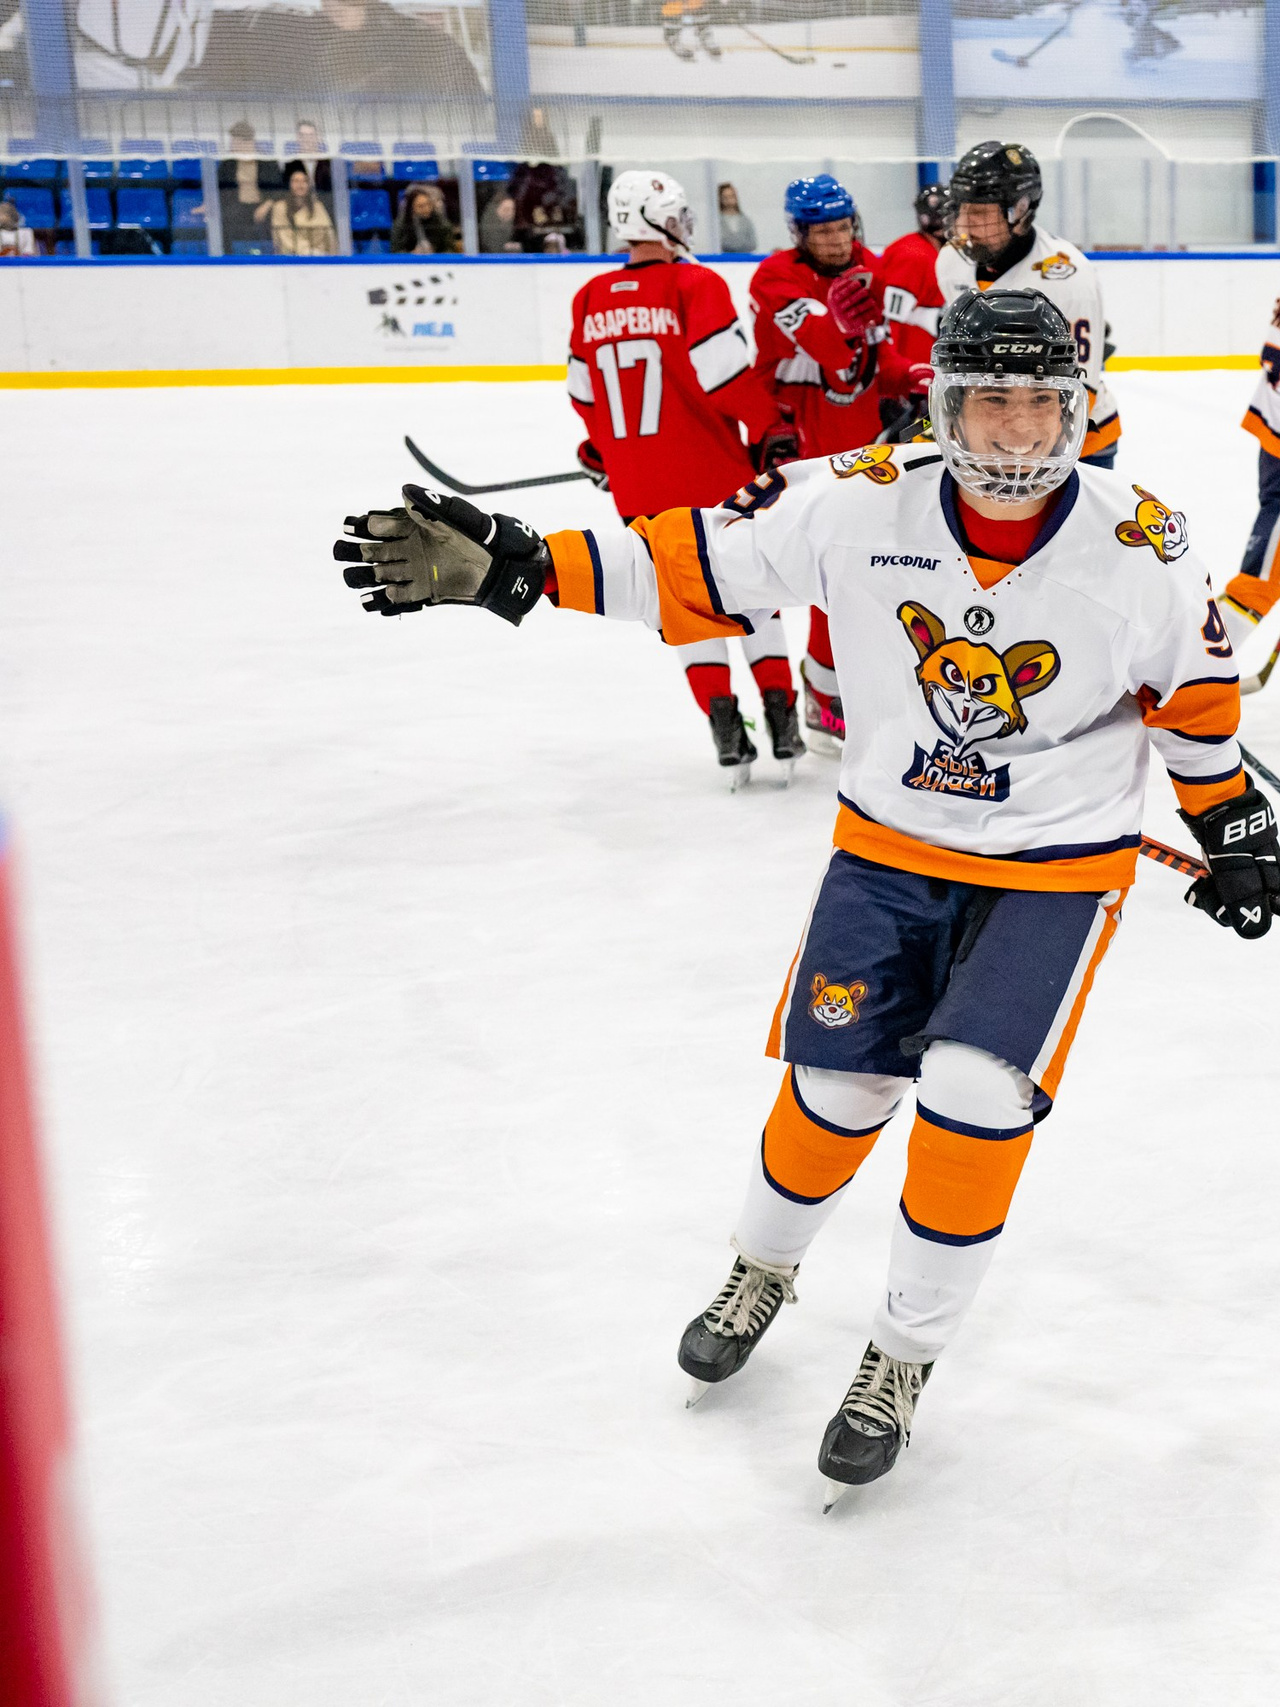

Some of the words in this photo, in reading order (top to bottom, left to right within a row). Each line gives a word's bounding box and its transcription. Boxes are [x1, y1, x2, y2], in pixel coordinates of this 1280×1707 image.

[992, 343, 1044, 355] CCM
[596, 339, 662, 439] 17
[871, 555, 941, 571] РУСФЛАГ
